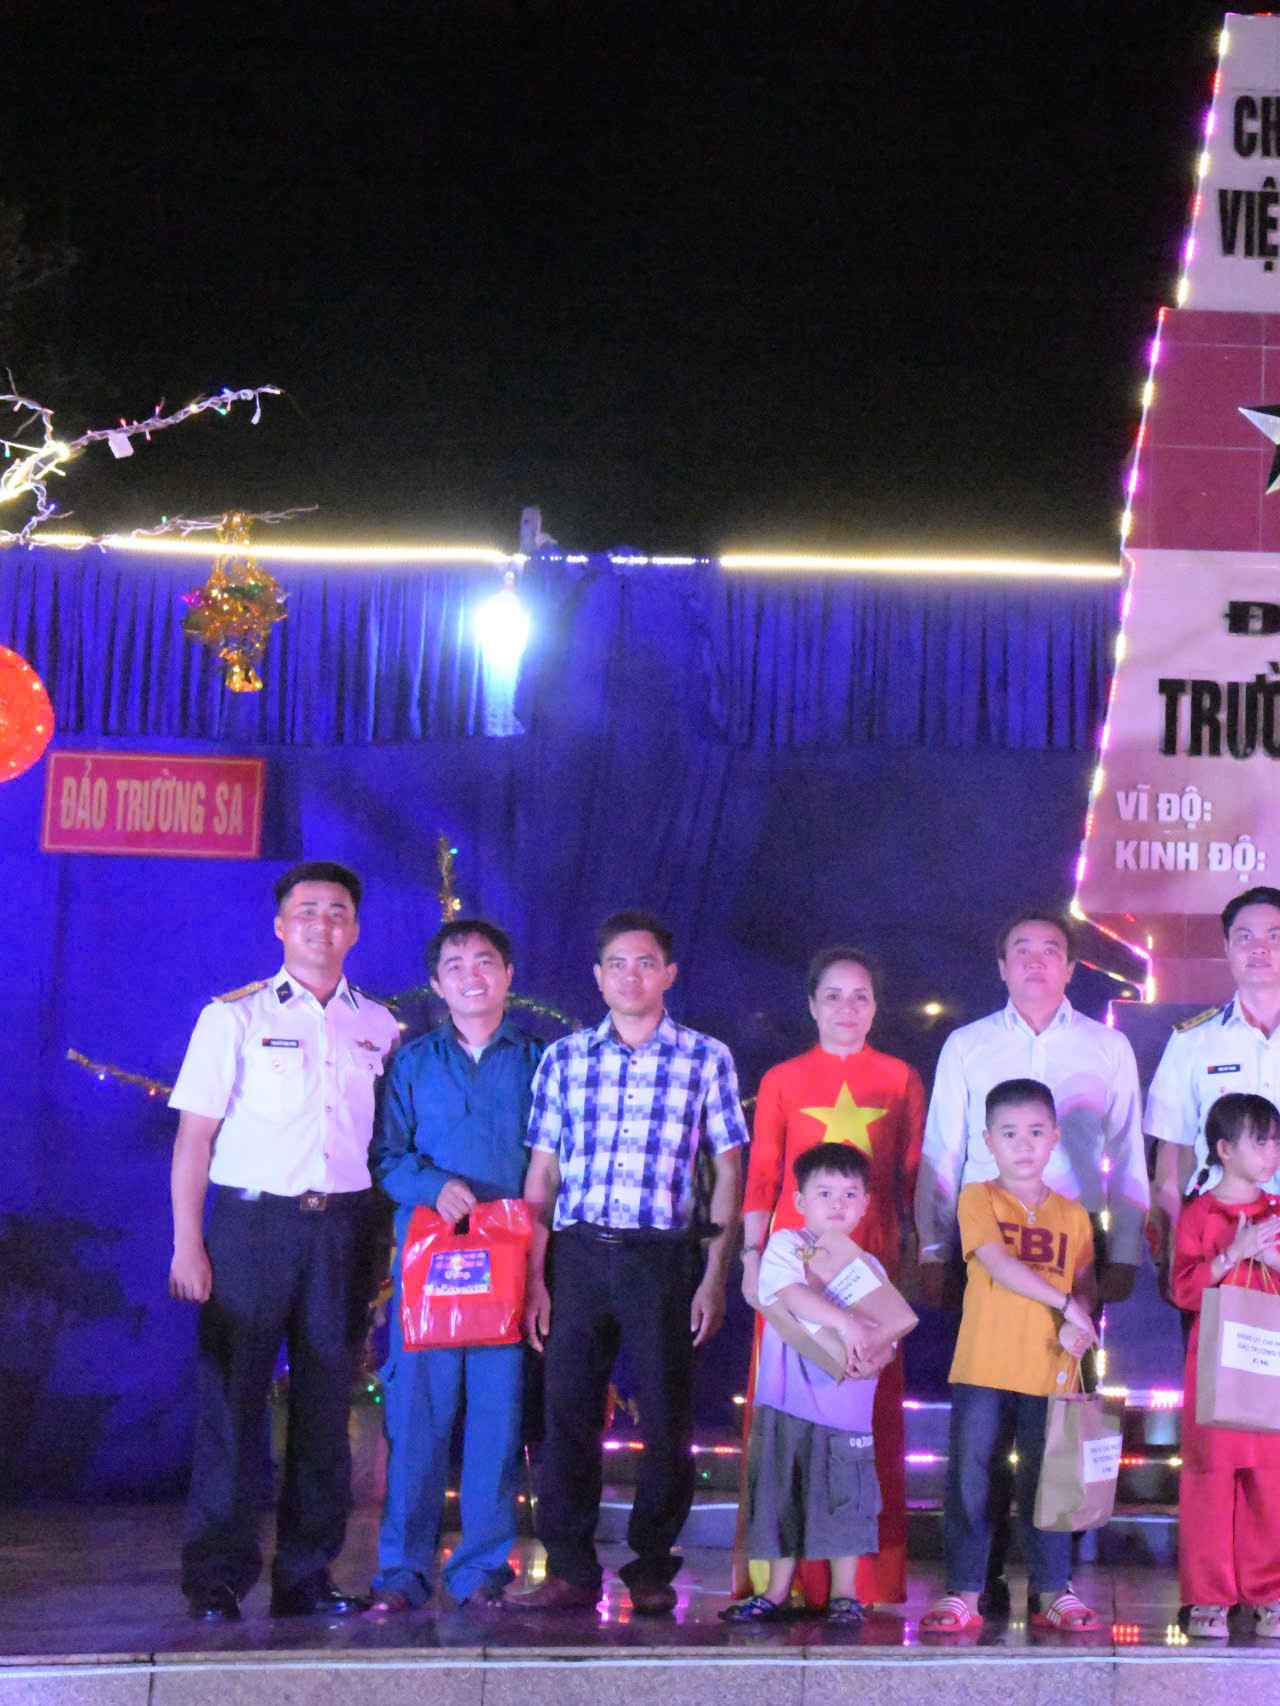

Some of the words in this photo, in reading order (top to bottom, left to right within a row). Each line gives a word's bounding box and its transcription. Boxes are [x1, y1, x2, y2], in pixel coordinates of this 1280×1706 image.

[60, 758, 108, 830] ĐẢO
[116, 768, 206, 833] TRƯỜNG
[213, 781, 244, 836] SA
[1116, 784, 1150, 822] VĨ
[1156, 785, 1212, 829] ĐỘ:
[1115, 840, 1199, 871] KINH
[1208, 834, 1266, 882] ĐỘ:
